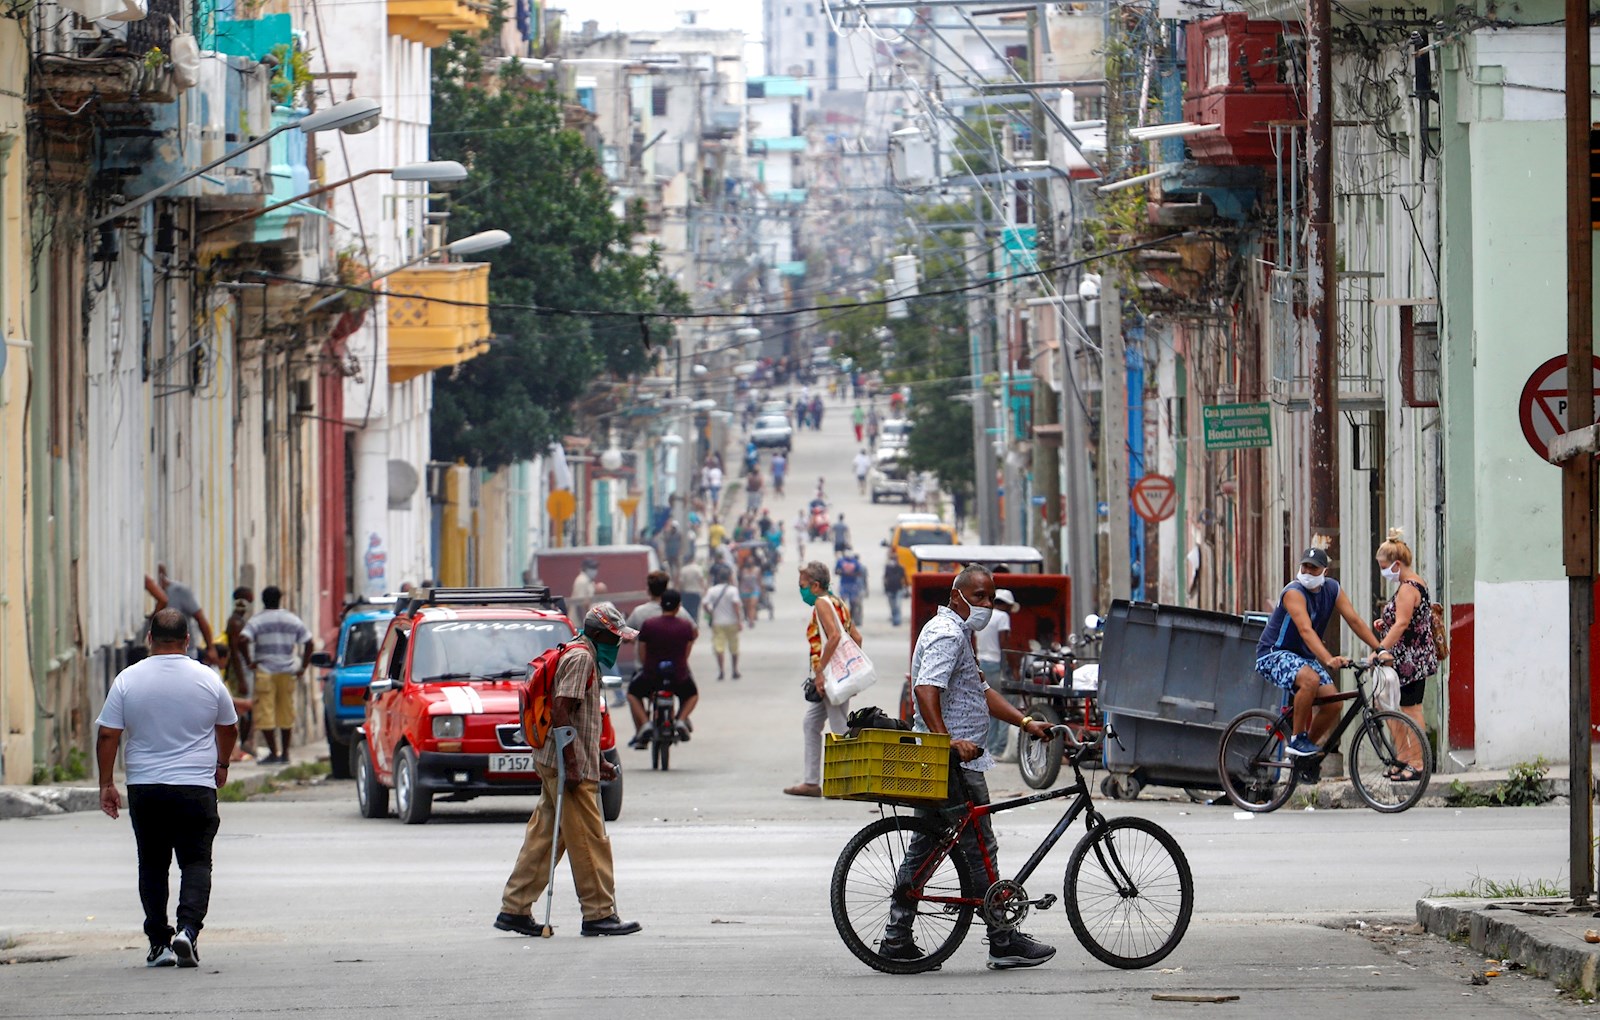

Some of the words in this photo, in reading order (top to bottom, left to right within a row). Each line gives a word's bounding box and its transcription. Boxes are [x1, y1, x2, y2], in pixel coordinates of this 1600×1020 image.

[1204, 408, 1219, 418] Casa
[1220, 408, 1235, 419] para
[1208, 428, 1235, 440] Hostal
[1237, 426, 1268, 438] Mirella
